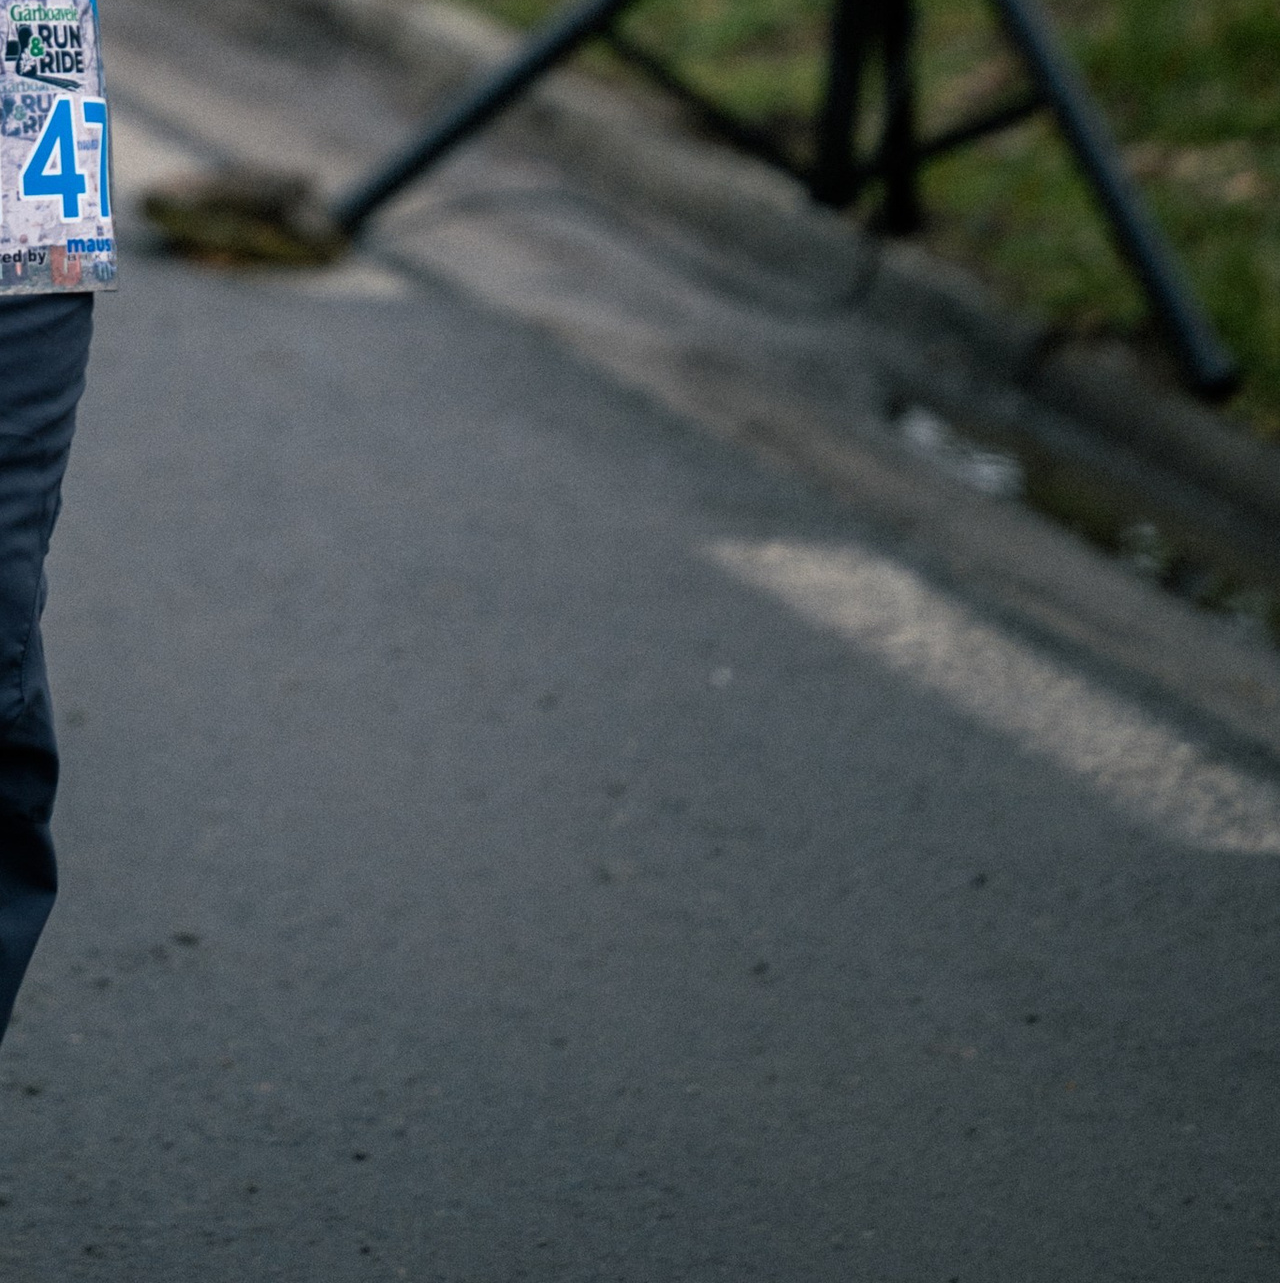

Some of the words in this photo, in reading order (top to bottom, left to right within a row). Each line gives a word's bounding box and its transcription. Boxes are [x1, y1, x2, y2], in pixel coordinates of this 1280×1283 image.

[38, 24, 82, 48] RUN
[30, 37, 44, 57] &
[40, 51, 84, 73] RIDE
[28, 250, 46, 265] by
